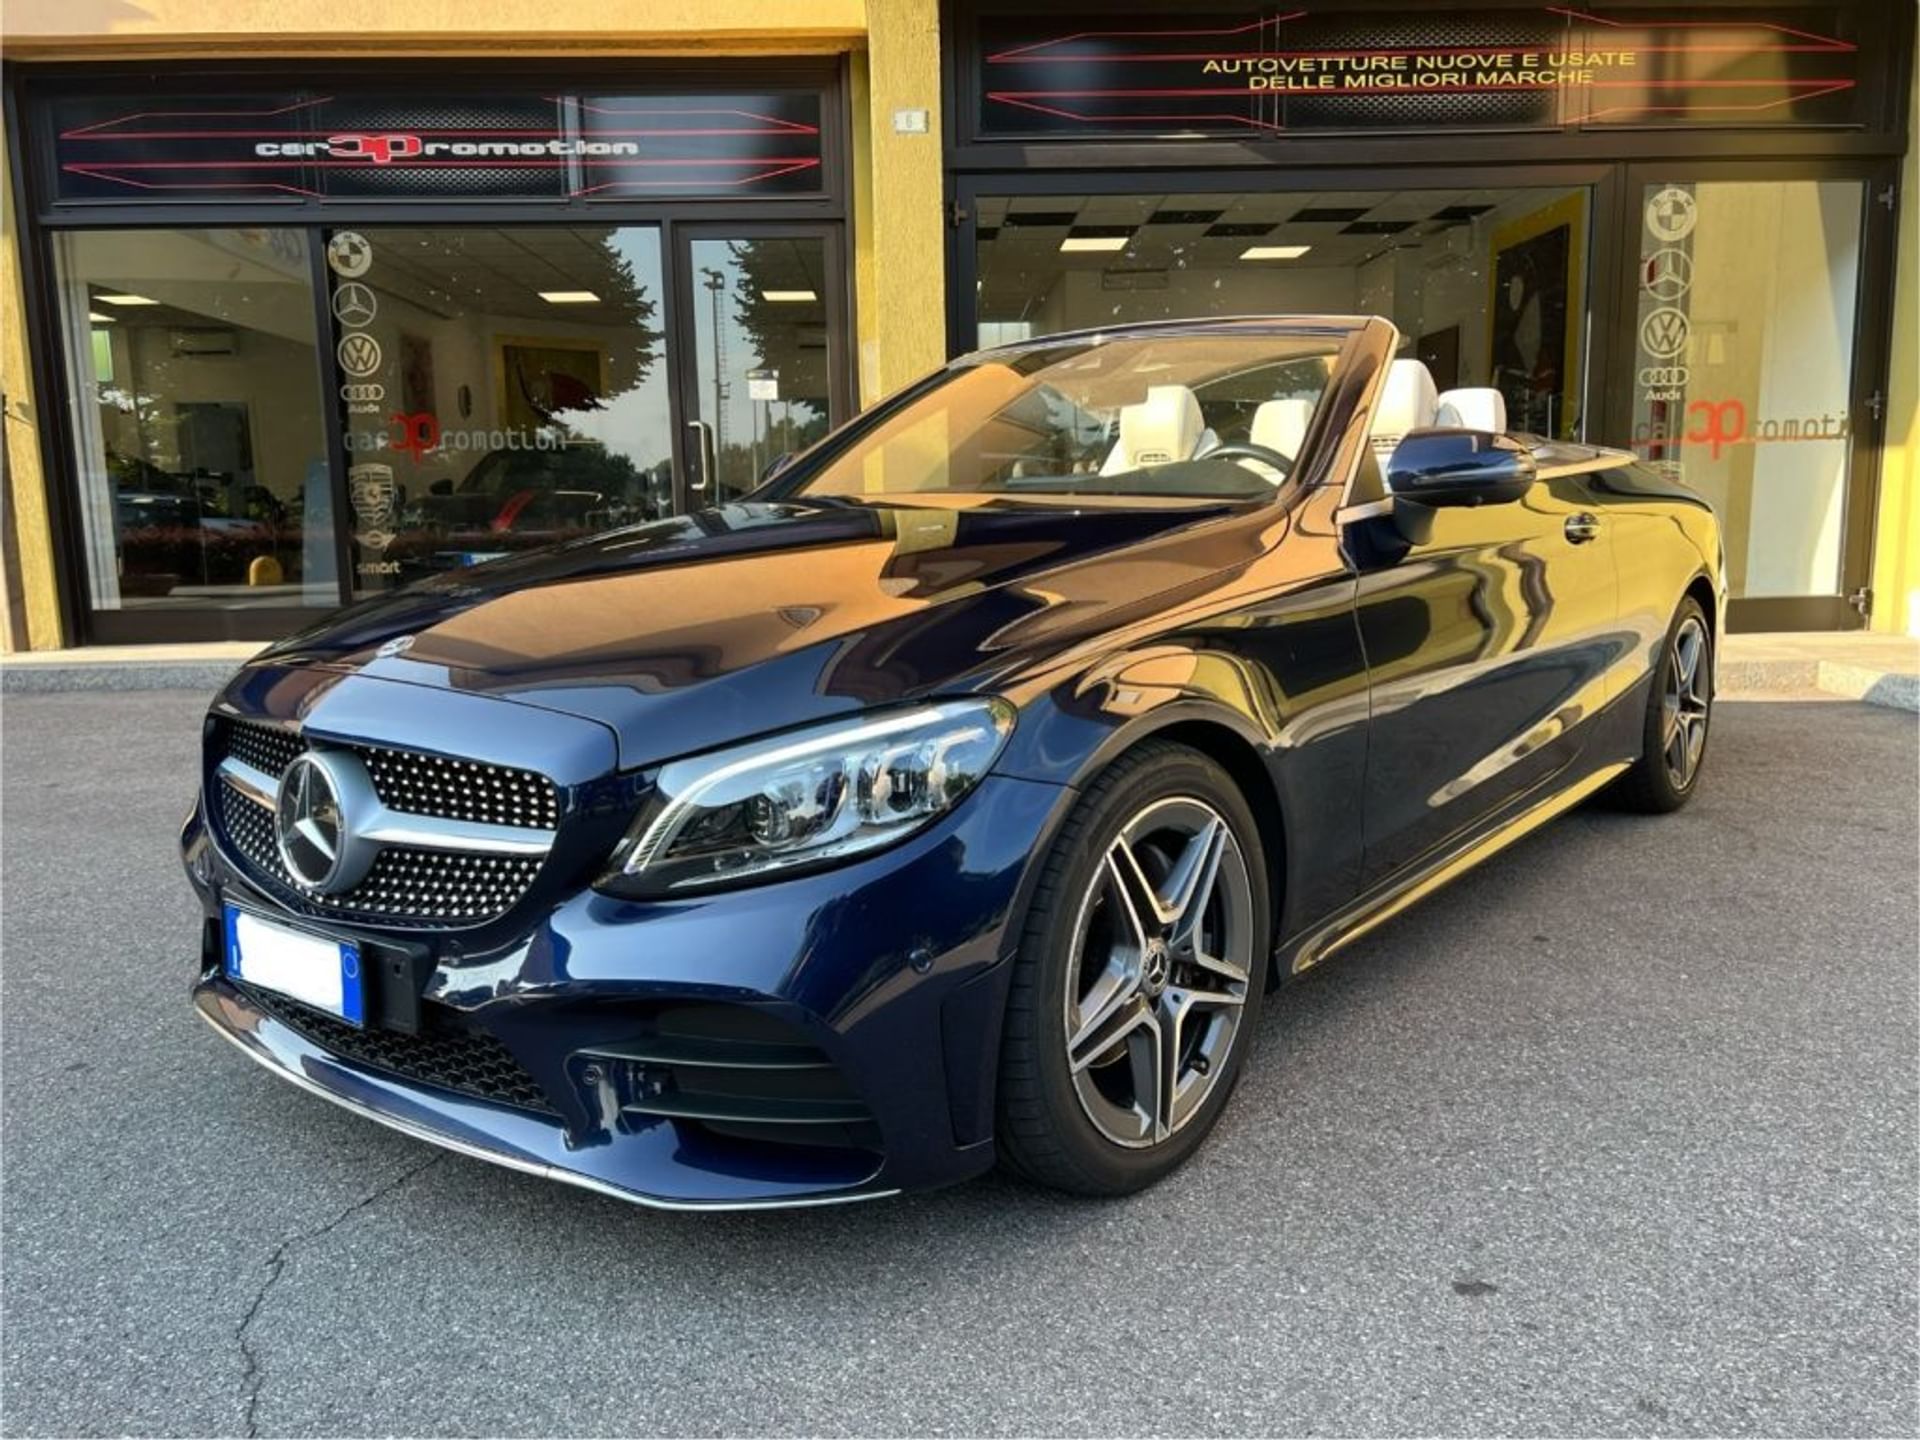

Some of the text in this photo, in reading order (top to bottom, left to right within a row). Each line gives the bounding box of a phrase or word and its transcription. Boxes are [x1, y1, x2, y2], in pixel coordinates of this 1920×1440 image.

[1202, 52, 1637, 73] AUTOVETTURE NUOVE E USATE
[1249, 70, 1594, 90] DELLE MIGLIORI MARCHE
[1643, 389, 1681, 402] Audi
[356, 555, 400, 574] smart
